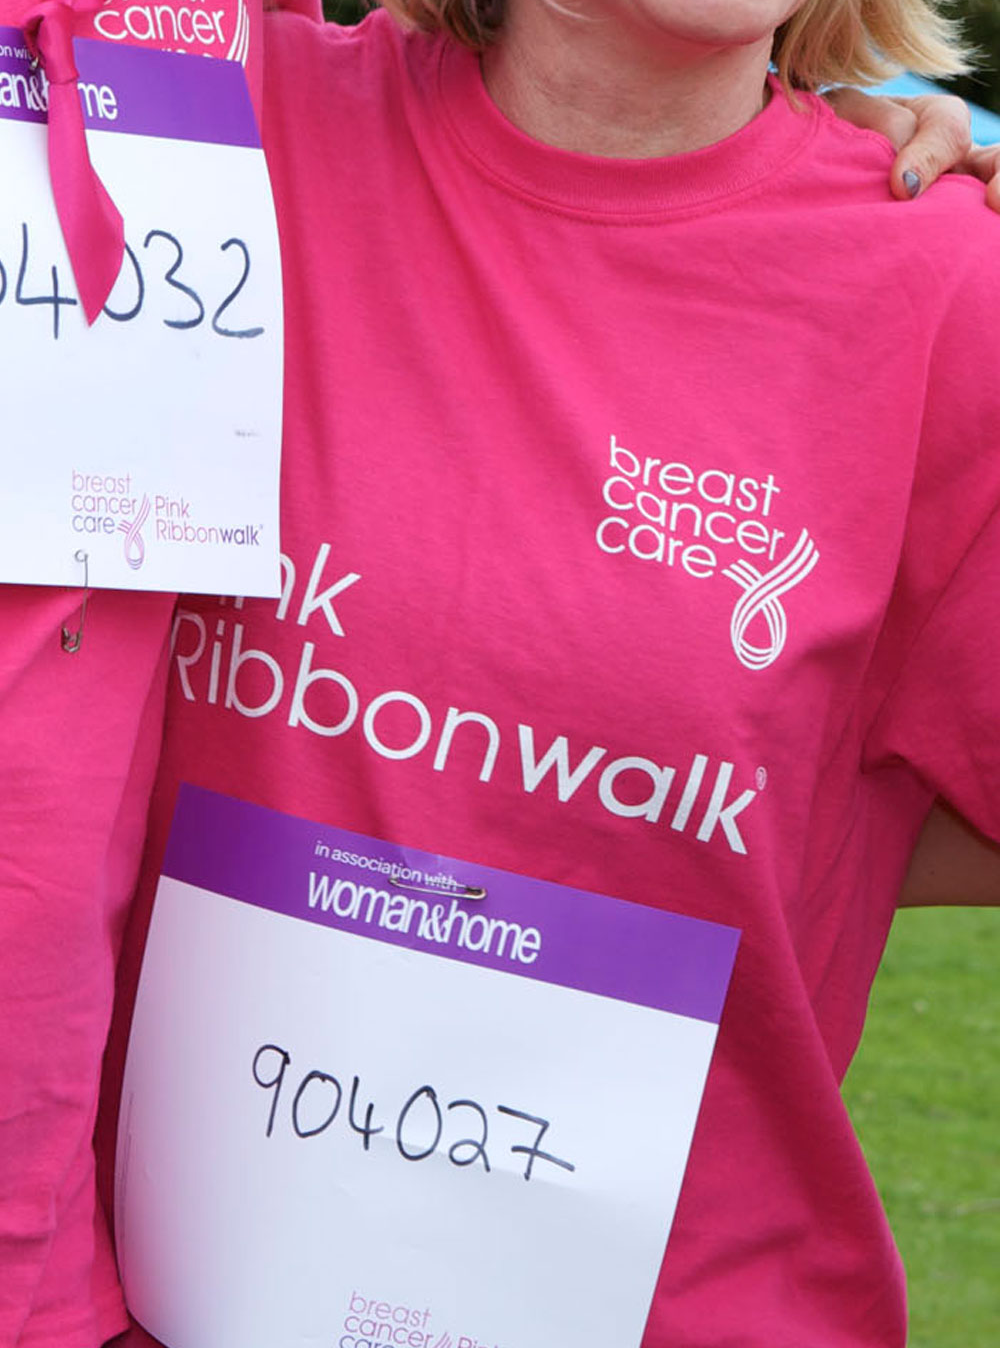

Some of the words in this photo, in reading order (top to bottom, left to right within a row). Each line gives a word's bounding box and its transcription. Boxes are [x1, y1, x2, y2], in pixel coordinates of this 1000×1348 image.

[93, 5, 226, 45] cancer
[71, 468, 133, 495] breast
[609, 434, 781, 517] breast
[71, 494, 137, 516] cancer
[71, 514, 116, 534] care
[154, 495, 191, 519] Pink
[602, 476, 785, 561] cancer
[596, 516, 718, 579] care
[314, 840, 329, 858] in
[331, 847, 423, 883] association
[307, 871, 542, 964] woman&home
[252, 1043, 576, 1182] 904027
[349, 1290, 433, 1329] breast
[343, 1315, 434, 1348] cancer
